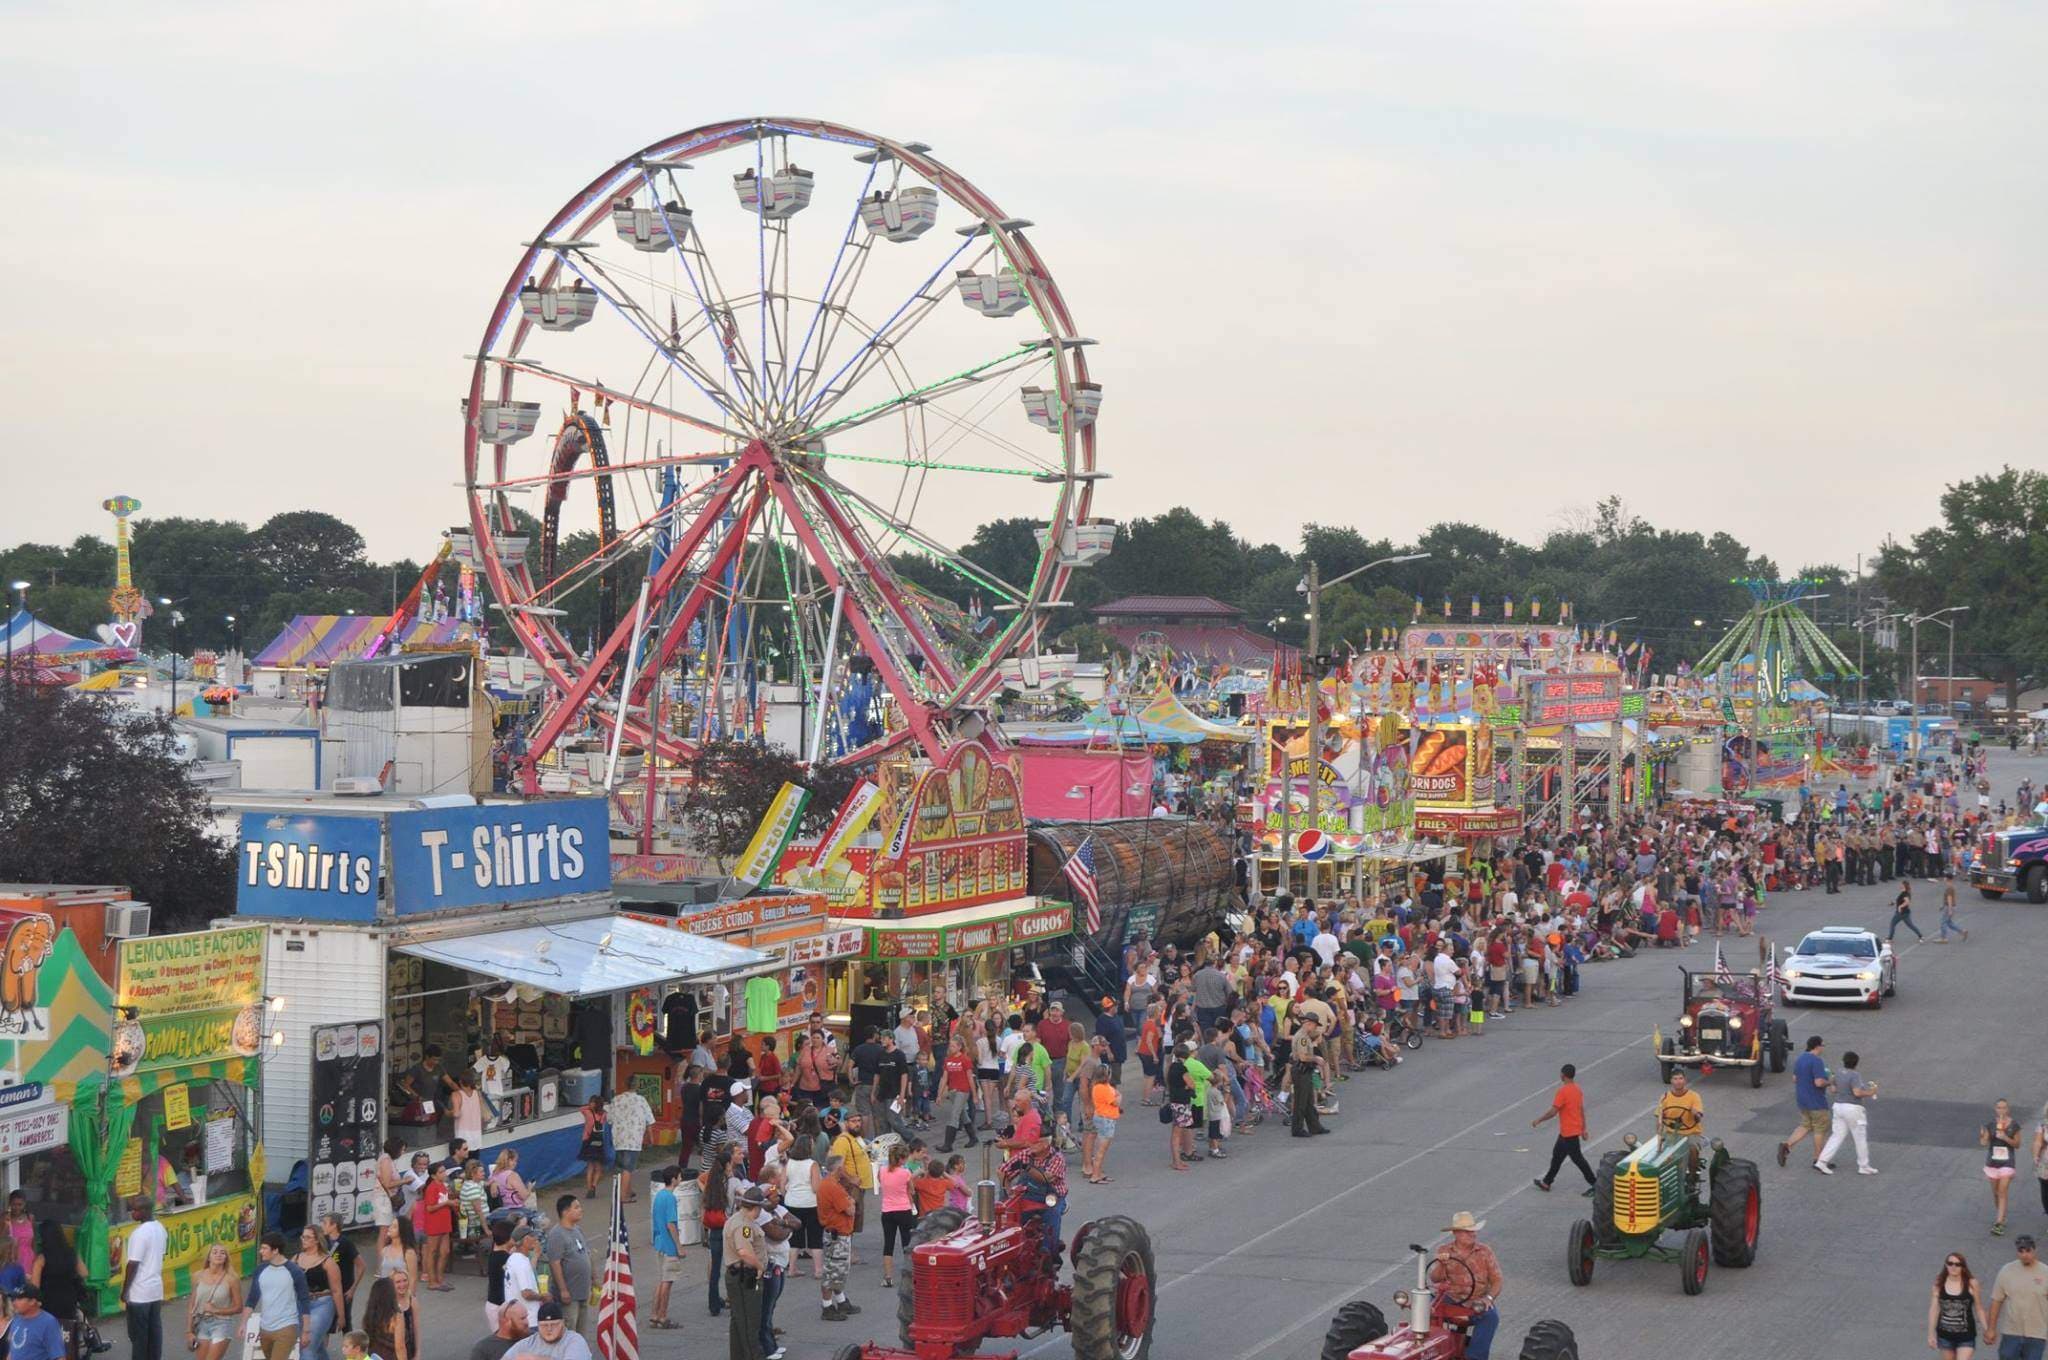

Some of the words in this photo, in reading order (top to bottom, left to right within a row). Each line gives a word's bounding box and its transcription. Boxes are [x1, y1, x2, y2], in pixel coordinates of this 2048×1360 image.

[1410, 776, 1430, 791] ORN
[1431, 776, 1457, 790] DOGS
[1417, 819, 1448, 830] FRIES
[245, 840, 372, 895] T-Shirts
[688, 916, 723, 935] CHEESE
[725, 910, 755, 929] CURDS
[1022, 913, 1062, 936] GYROS
[127, 939, 201, 964] LEMONADE
[205, 930, 262, 955] FACTORY
[963, 928, 992, 949] SAUSAGE
[146, 1028, 192, 1060] FUNNEL
